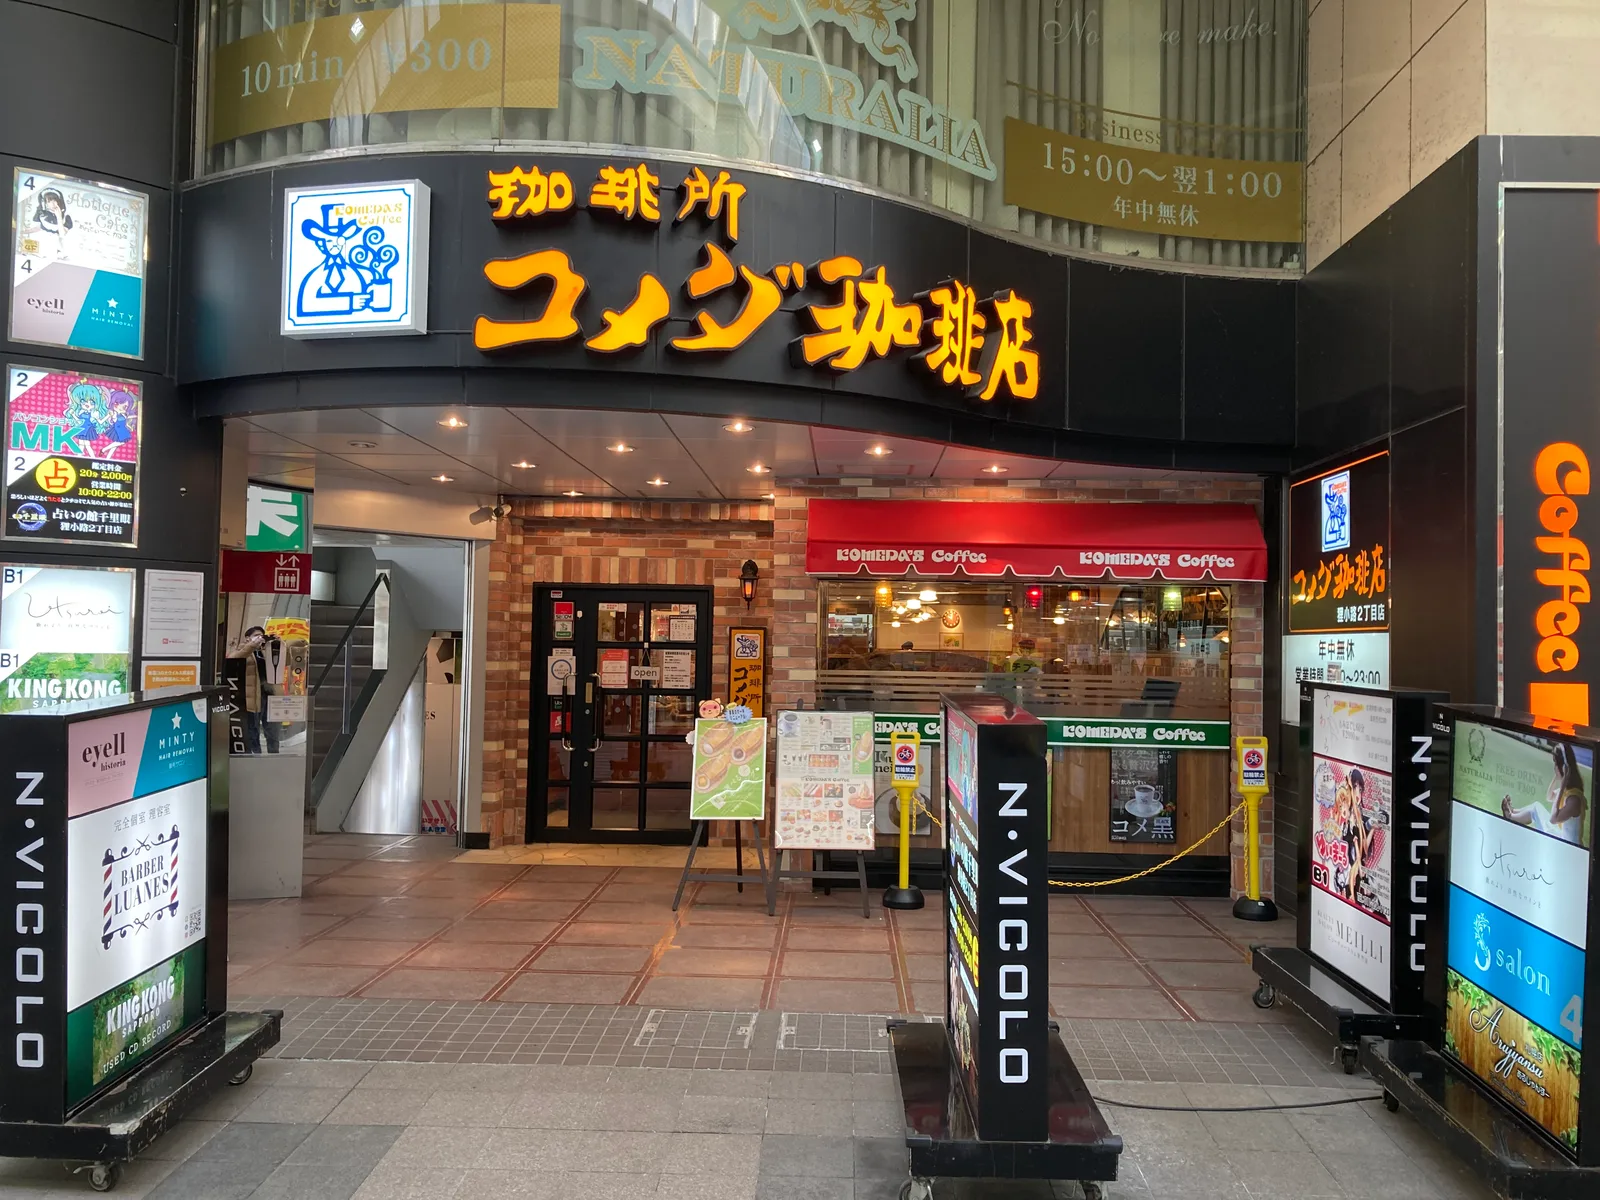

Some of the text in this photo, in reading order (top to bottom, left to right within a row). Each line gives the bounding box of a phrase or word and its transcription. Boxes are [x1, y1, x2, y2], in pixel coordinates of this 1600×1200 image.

[24, 176, 35, 190] 4
[66, 192, 130, 218] Antique
[489, 163, 746, 241] 珈琲所
[1113, 195, 1199, 227] 年中無休
[96, 214, 128, 233] Cafe
[21, 259, 32, 273] 4
[27, 297, 64, 310] eyell
[92, 308, 134, 321] MINTY
[473, 241, 1040, 401] コメダ珈琲店
[17, 373, 28, 386] 2
[11, 422, 85, 454] MK
[14, 457, 25, 470] 2
[44, 460, 69, 489] 占
[91, 481, 122, 490] 営業時間
[52, 508, 131, 524] 占いの館千里眼
[836, 549, 987, 564] KOMEDA'S Coffee
[1079, 552, 1235, 569] KOMEDA'S Coffee
[1535, 442, 1590, 673] Coffee
[4, 569, 23, 583] B1
[1292, 543, 1386, 605] コメダ珈琲店
[1319, 639, 1354, 660] 年中無休
[1, 653, 19, 668] B1
[634, 669, 657, 678] open
[8, 678, 121, 699] KING KONG
[212, 704, 230, 713] VICOLO
[1062, 725, 1206, 742] KOMEDA'S Coffee
[1432, 723, 1450, 732] VICOLO
[82, 732, 126, 767] eyell
[159, 732, 195, 749] MINTY
[101, 759, 126, 772] historia
[159, 752, 171, 761] HAIR
[114, 803, 170, 832] 完全個室 理容室
[121, 855, 164, 887] BARBER
[1313, 865, 1328, 886] B1
[113, 872, 170, 915] LUANES
[1336, 920, 1383, 963] MEILLI
[1495, 948, 1551, 997] salon
[107, 976, 175, 1035] KING KONG
[122, 1008, 161, 1038] SAPPORO
[1560, 994, 1583, 1045] 4
[103, 1019, 172, 1074] USED CD RECORD
